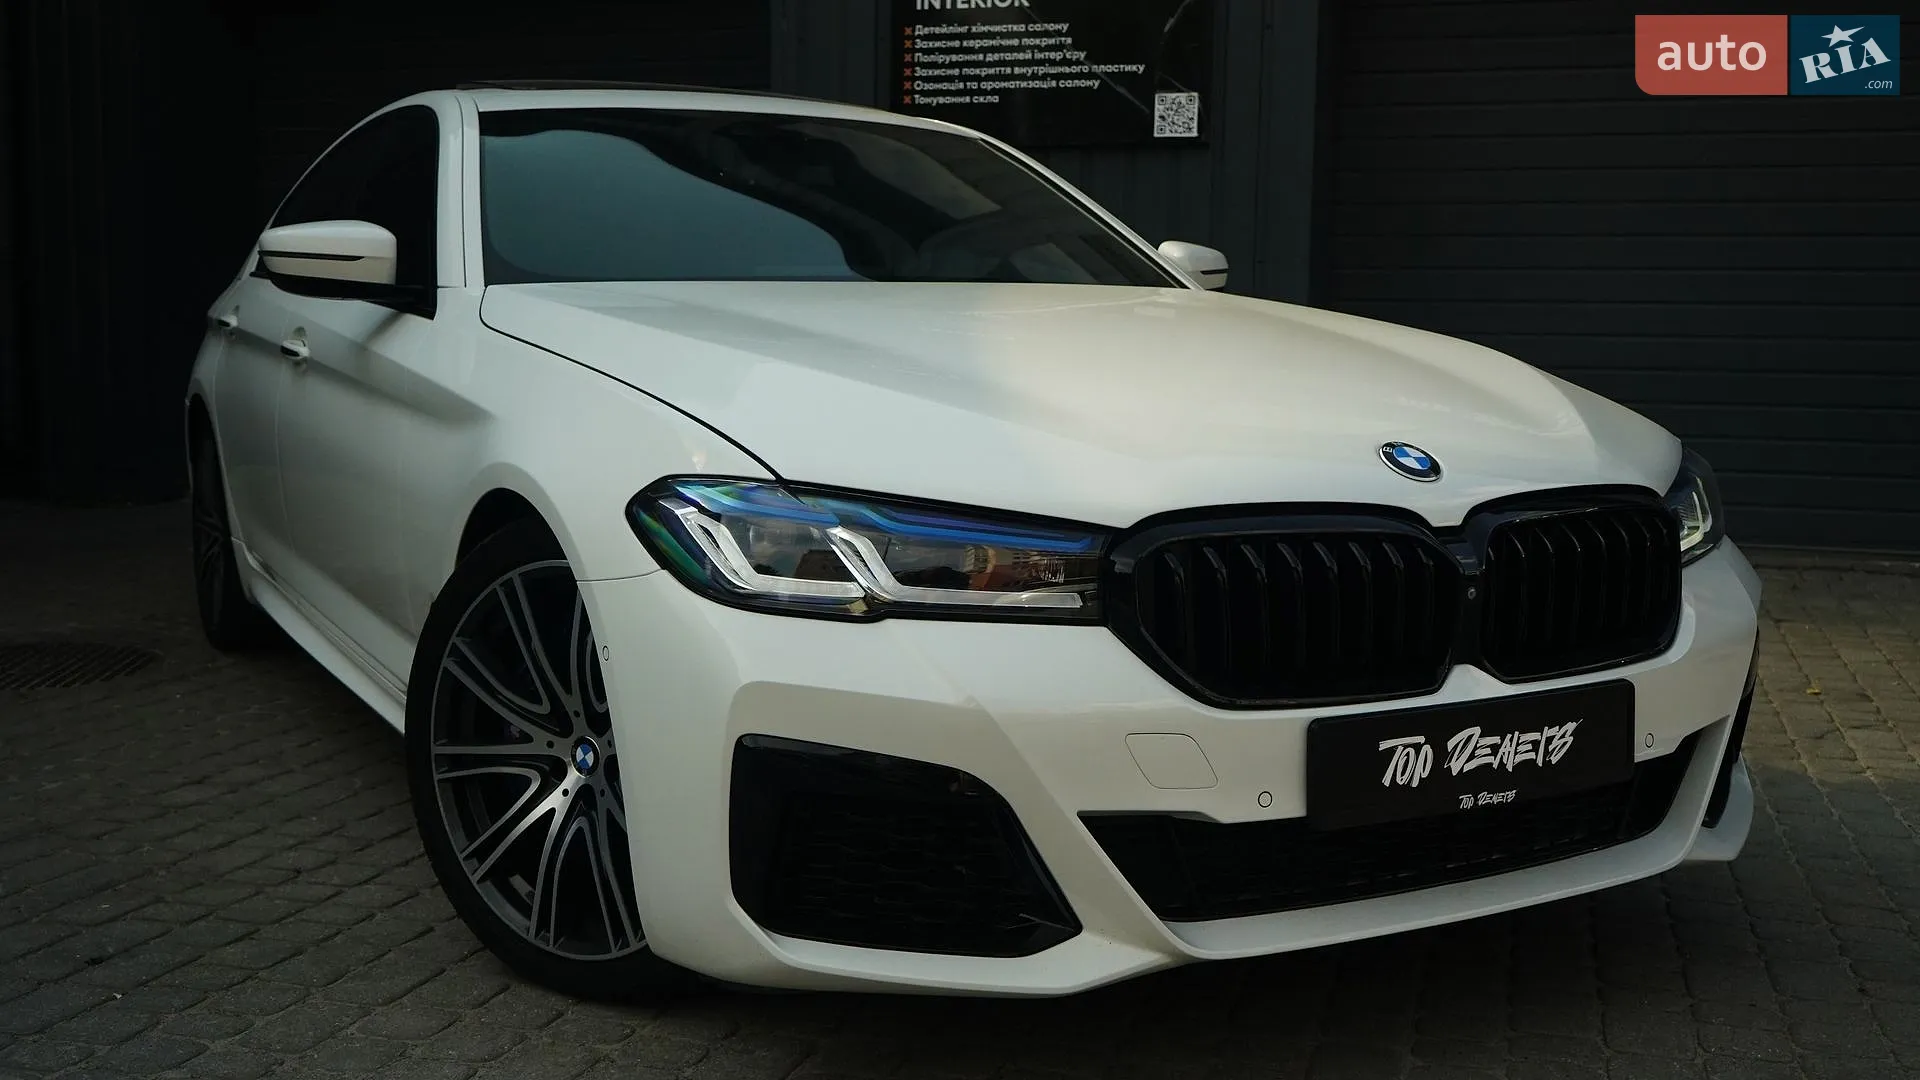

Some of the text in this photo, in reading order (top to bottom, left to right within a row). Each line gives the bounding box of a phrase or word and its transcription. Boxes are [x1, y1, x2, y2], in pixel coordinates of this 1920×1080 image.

[914, 24, 969, 36] Детейлінг
[1027, 23, 1069, 33] салону
[914, 39, 961, 49] Захисне
[1021, 37, 1072, 48] покриття
[914, 52, 984, 64] Полірування
[985, 49, 1033, 62] деталей
[913, 63, 1146, 77] Захисне покриття внутрішнього пластику
[913, 77, 1100, 91] Озонація та ароматизація салону
[913, 94, 999, 106] Тонування скла
